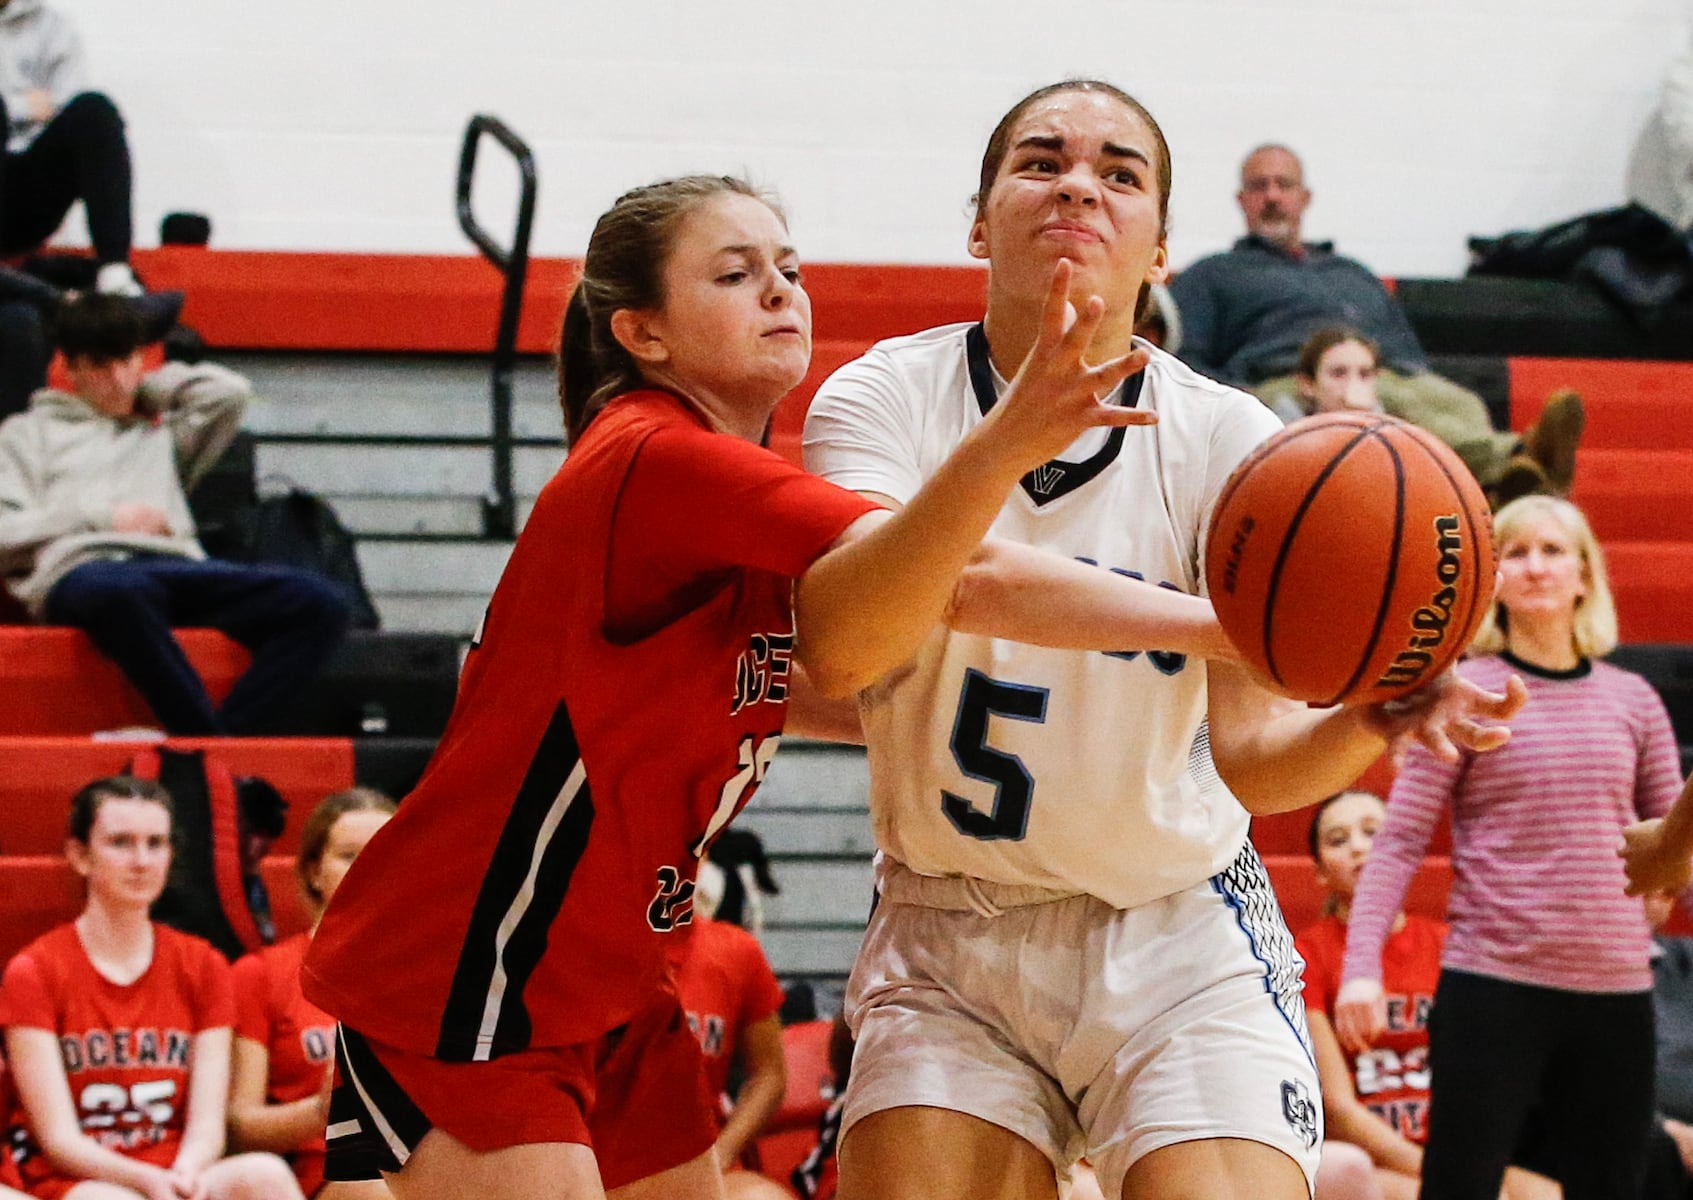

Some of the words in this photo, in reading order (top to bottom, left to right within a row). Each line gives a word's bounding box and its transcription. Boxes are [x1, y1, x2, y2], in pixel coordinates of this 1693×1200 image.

[1377, 513, 1463, 687] Wilson
[940, 667, 1050, 841] 5
[60, 1027, 192, 1075] OCEAN
